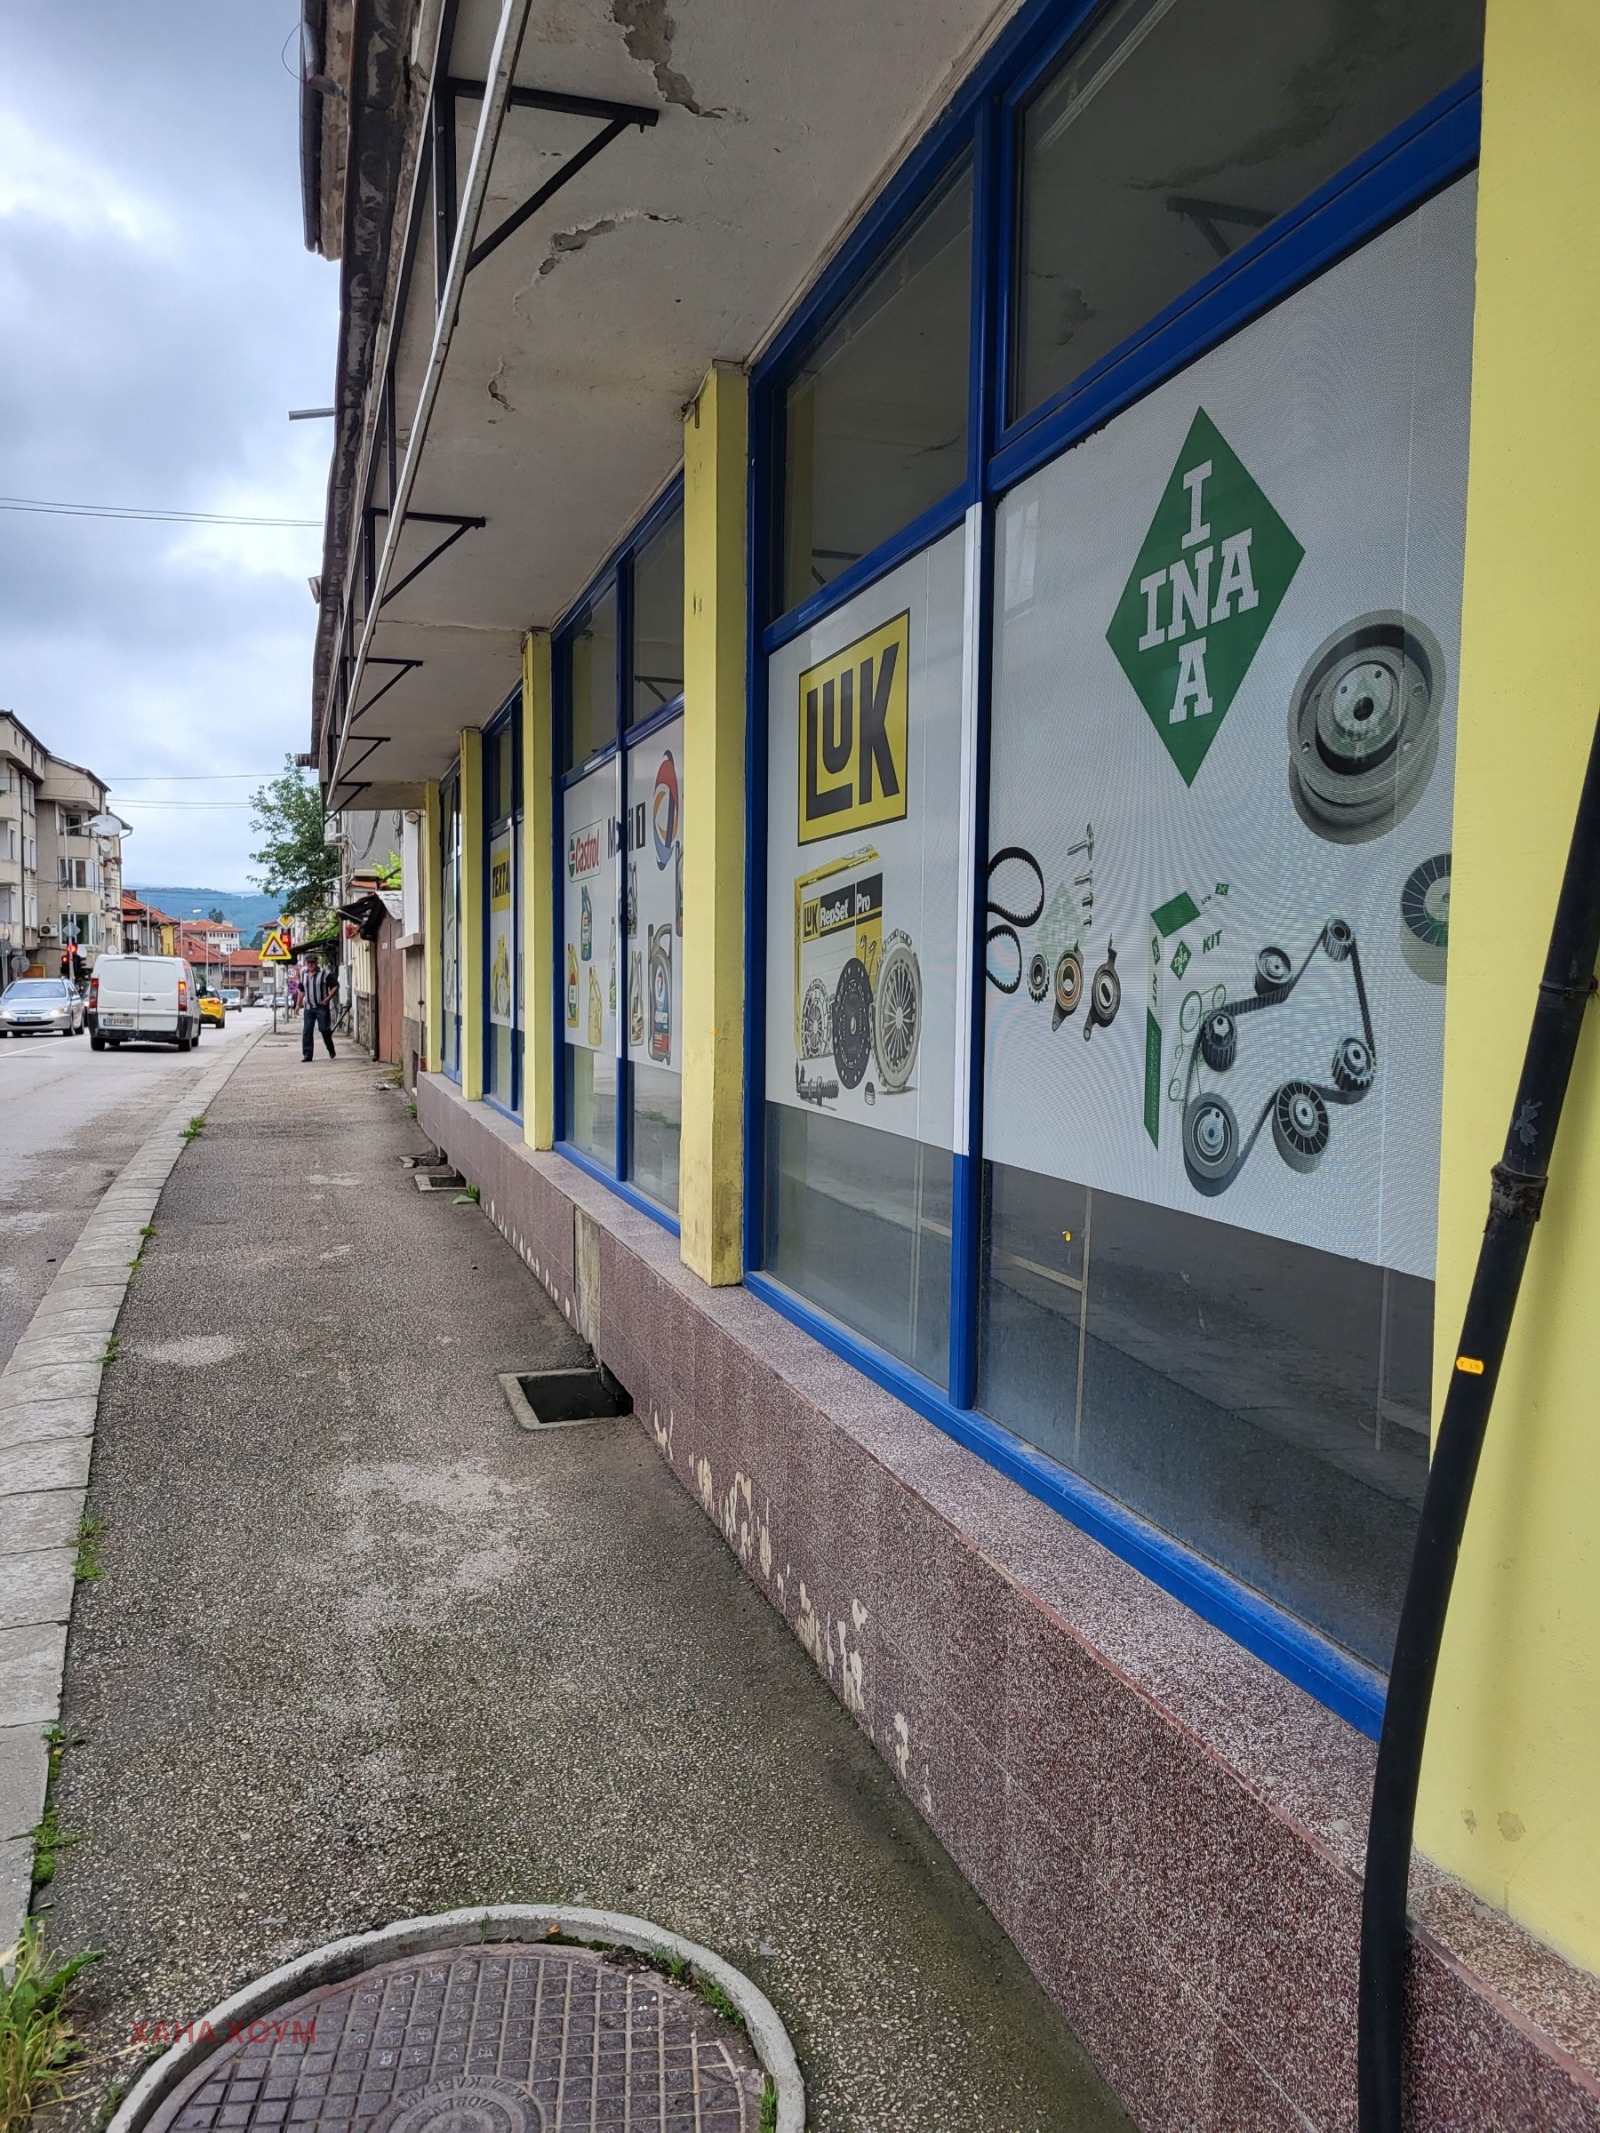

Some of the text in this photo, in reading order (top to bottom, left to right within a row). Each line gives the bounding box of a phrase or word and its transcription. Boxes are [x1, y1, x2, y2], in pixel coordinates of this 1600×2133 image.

[1138, 527, 1259, 652] INA
[576, 828, 600, 875] Castrol
[820, 898, 849, 928] RepSet
[856, 893, 871, 915] Pro
[1203, 930, 1222, 954] KIT
